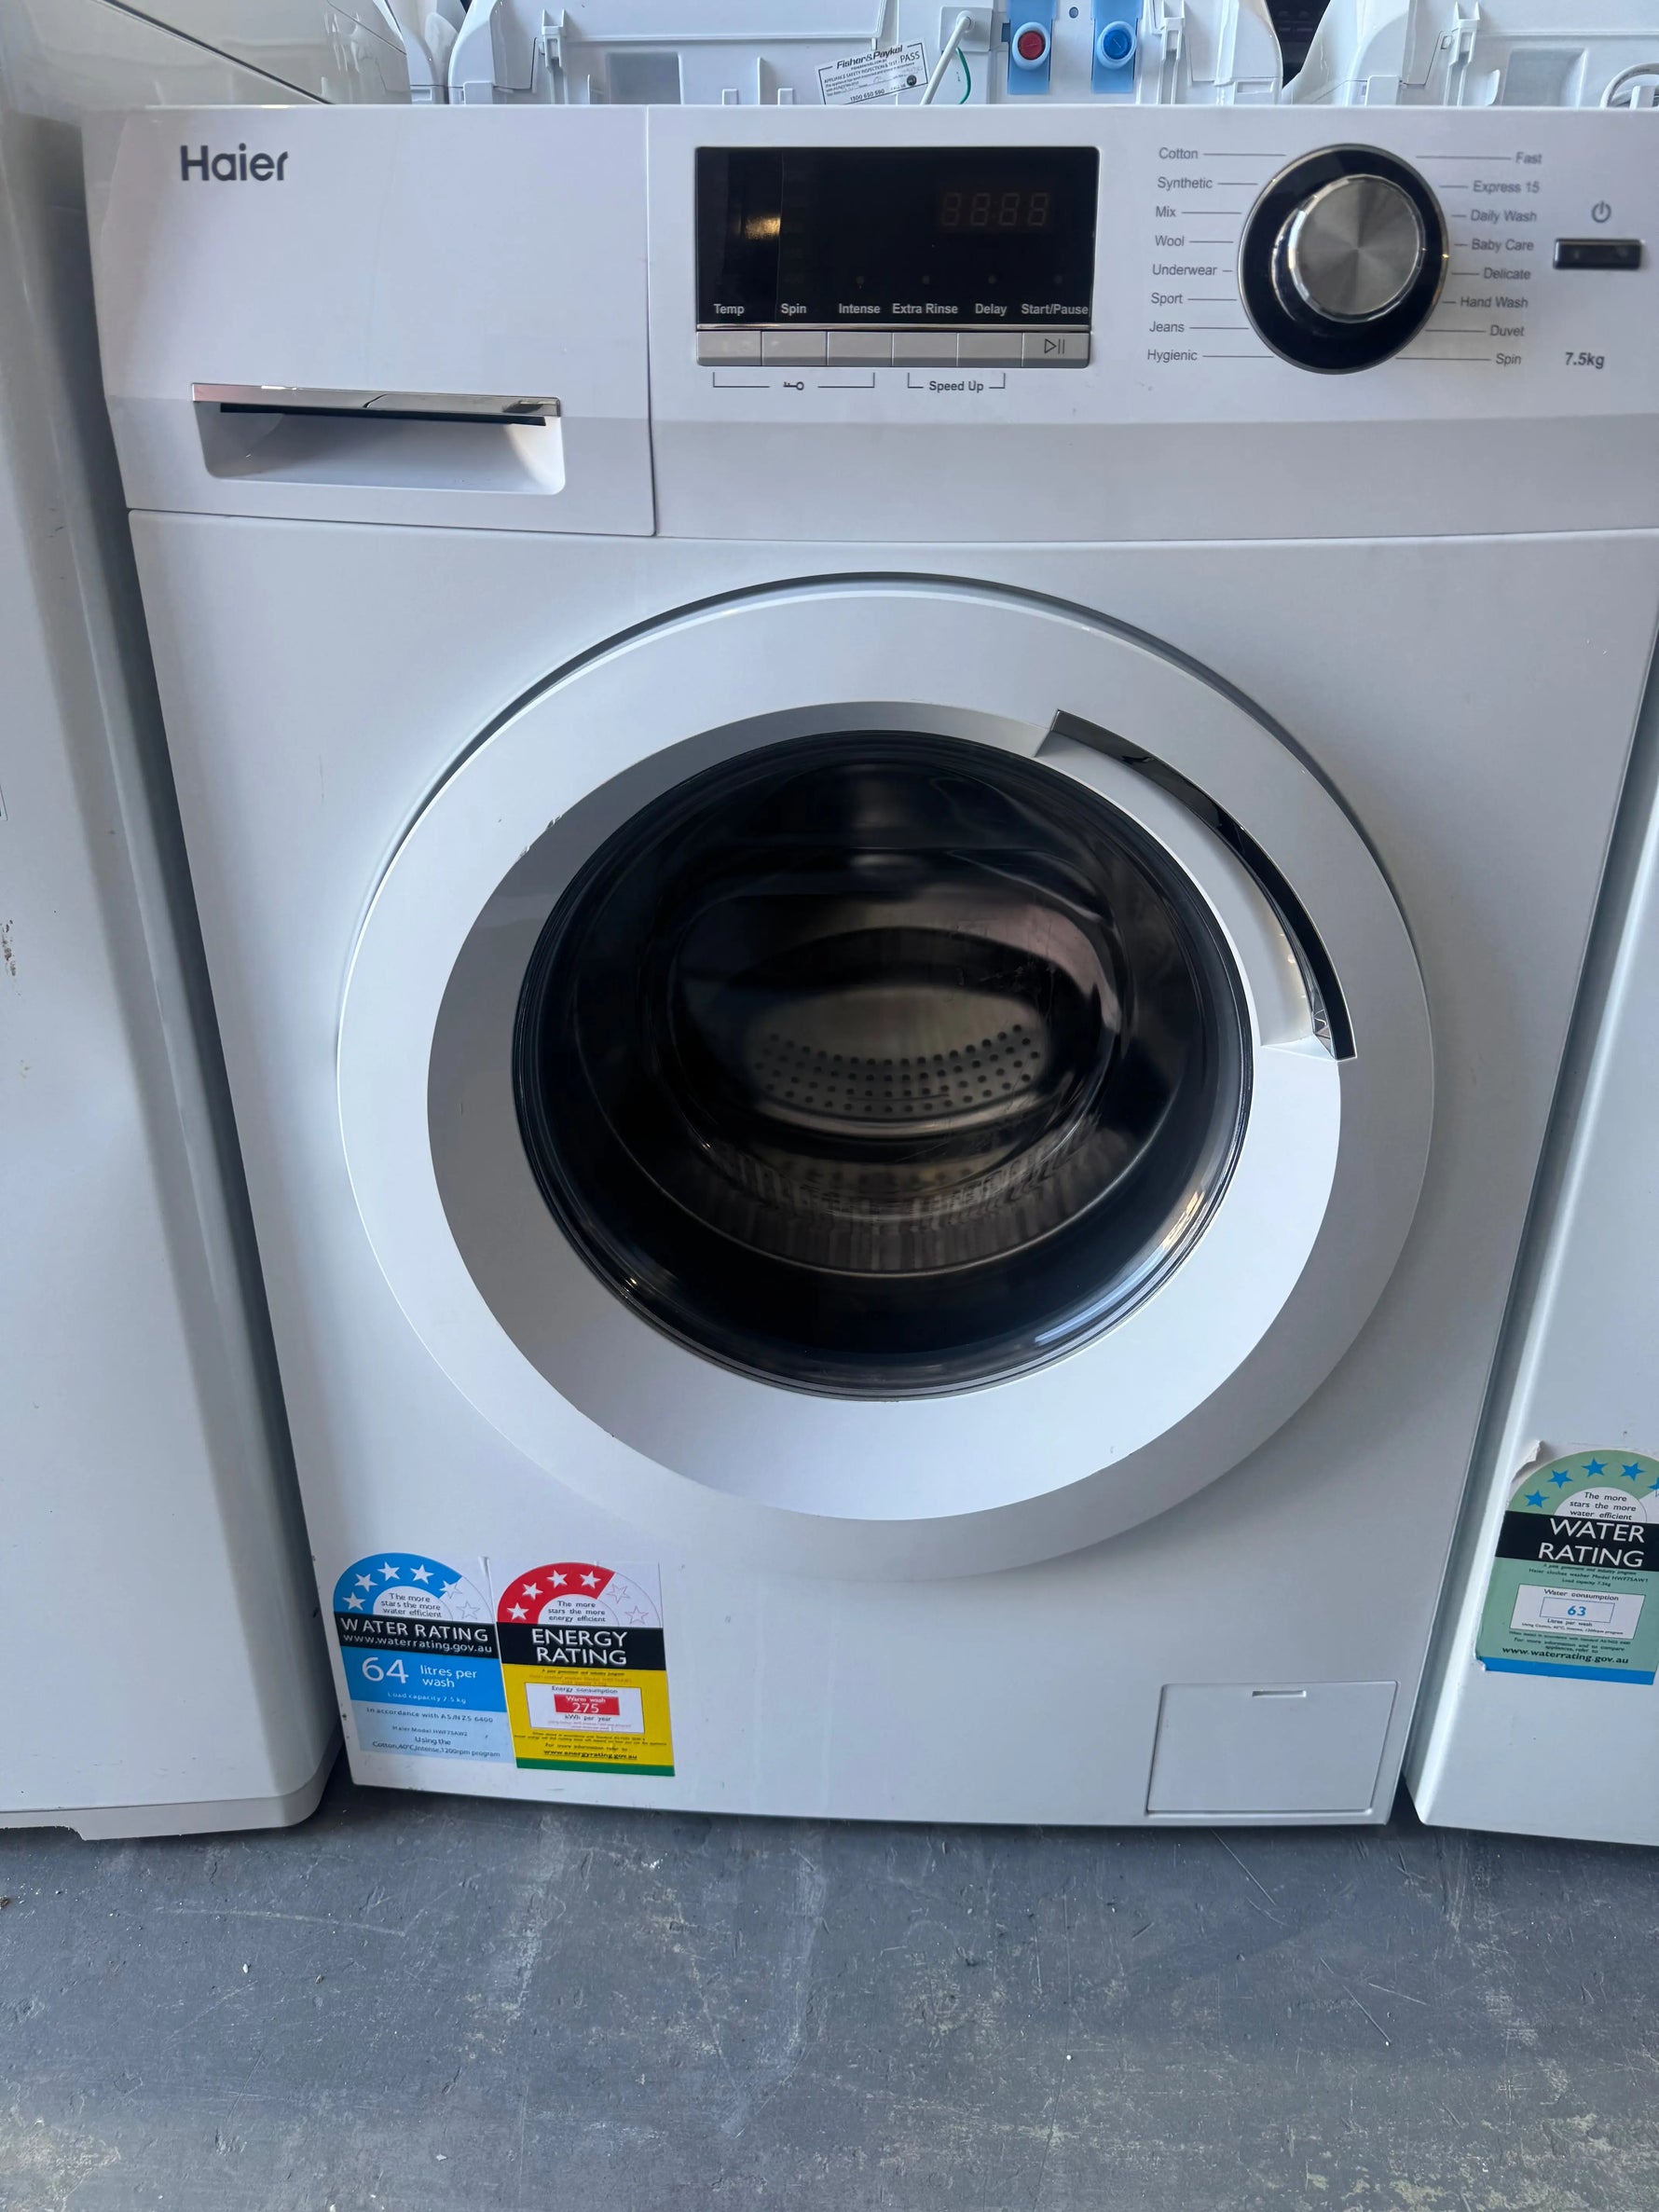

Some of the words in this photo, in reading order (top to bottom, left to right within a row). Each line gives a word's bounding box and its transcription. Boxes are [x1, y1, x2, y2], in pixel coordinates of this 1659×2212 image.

[837, 45, 903, 69] Fisher&Paykel
[900, 51, 920, 63] PASS
[1159, 147, 1199, 159] Cotton
[1515, 152, 1542, 164] Fast
[181, 143, 288, 181] Haier
[1158, 176, 1213, 191] Synthetic
[1473, 180, 1521, 194] Express
[1526, 181, 1540, 193] 15
[1156, 206, 1176, 217] Mix
[1471, 209, 1500, 224] Daily
[1503, 210, 1536, 222] Wash
[1156, 235, 1185, 247] Wool
[1471, 239, 1501, 254] Baby
[1505, 240, 1534, 251] Care
[1152, 264, 1217, 275] Underwear
[1484, 268, 1530, 280] Delicate
[1151, 293, 1183, 306] Sport
[1460, 296, 1491, 308] Hand
[1495, 297, 1529, 309] Wash
[713, 303, 745, 315] Temp
[781, 303, 806, 315] Spin
[839, 303, 881, 314] Intense
[892, 303, 923, 314] Extra
[925, 303, 958, 314] Rinse
[975, 304, 1007, 316] Delay
[1021, 304, 1089, 315] Start/Pause
[1149, 322, 1185, 333] Jeans
[1490, 324, 1525, 337] Duvet
[1147, 350, 1198, 363] Hygienic
[1496, 353, 1521, 365] Spin
[1565, 352, 1605, 369] 7.5kg
[929, 380, 964, 392] Speed
[968, 380, 983, 392] Up
[1599, 1512, 1632, 1520] efficient
[1550, 1518, 1645, 1544] WATER
[1538, 1542, 1645, 1567] RATING
[389, 1592, 405, 1601] The
[1571, 1592, 1619, 1601] consumption
[381, 1600, 402, 1608] stars
[383, 1607, 406, 1615] water
[409, 1610, 442, 1618] efficient
[1567, 1605, 1586, 1616] 63
[340, 1617, 408, 1636] WATER
[415, 1624, 488, 1642] RATING
[531, 1628, 627, 1647] ENERGY
[343, 1634, 492, 1654] www.waterrating.gov.au
[536, 1647, 627, 1665] RATING
[1502, 1646, 1629, 1665] www.waterrating.gov.au
[362, 1656, 409, 1684] 64
[420, 1665, 453, 1677] litres
[456, 1669, 477, 1679] per
[422, 1678, 455, 1688] wash
[572, 1702, 599, 1713] 275
[415, 1737, 437, 1745] Using
